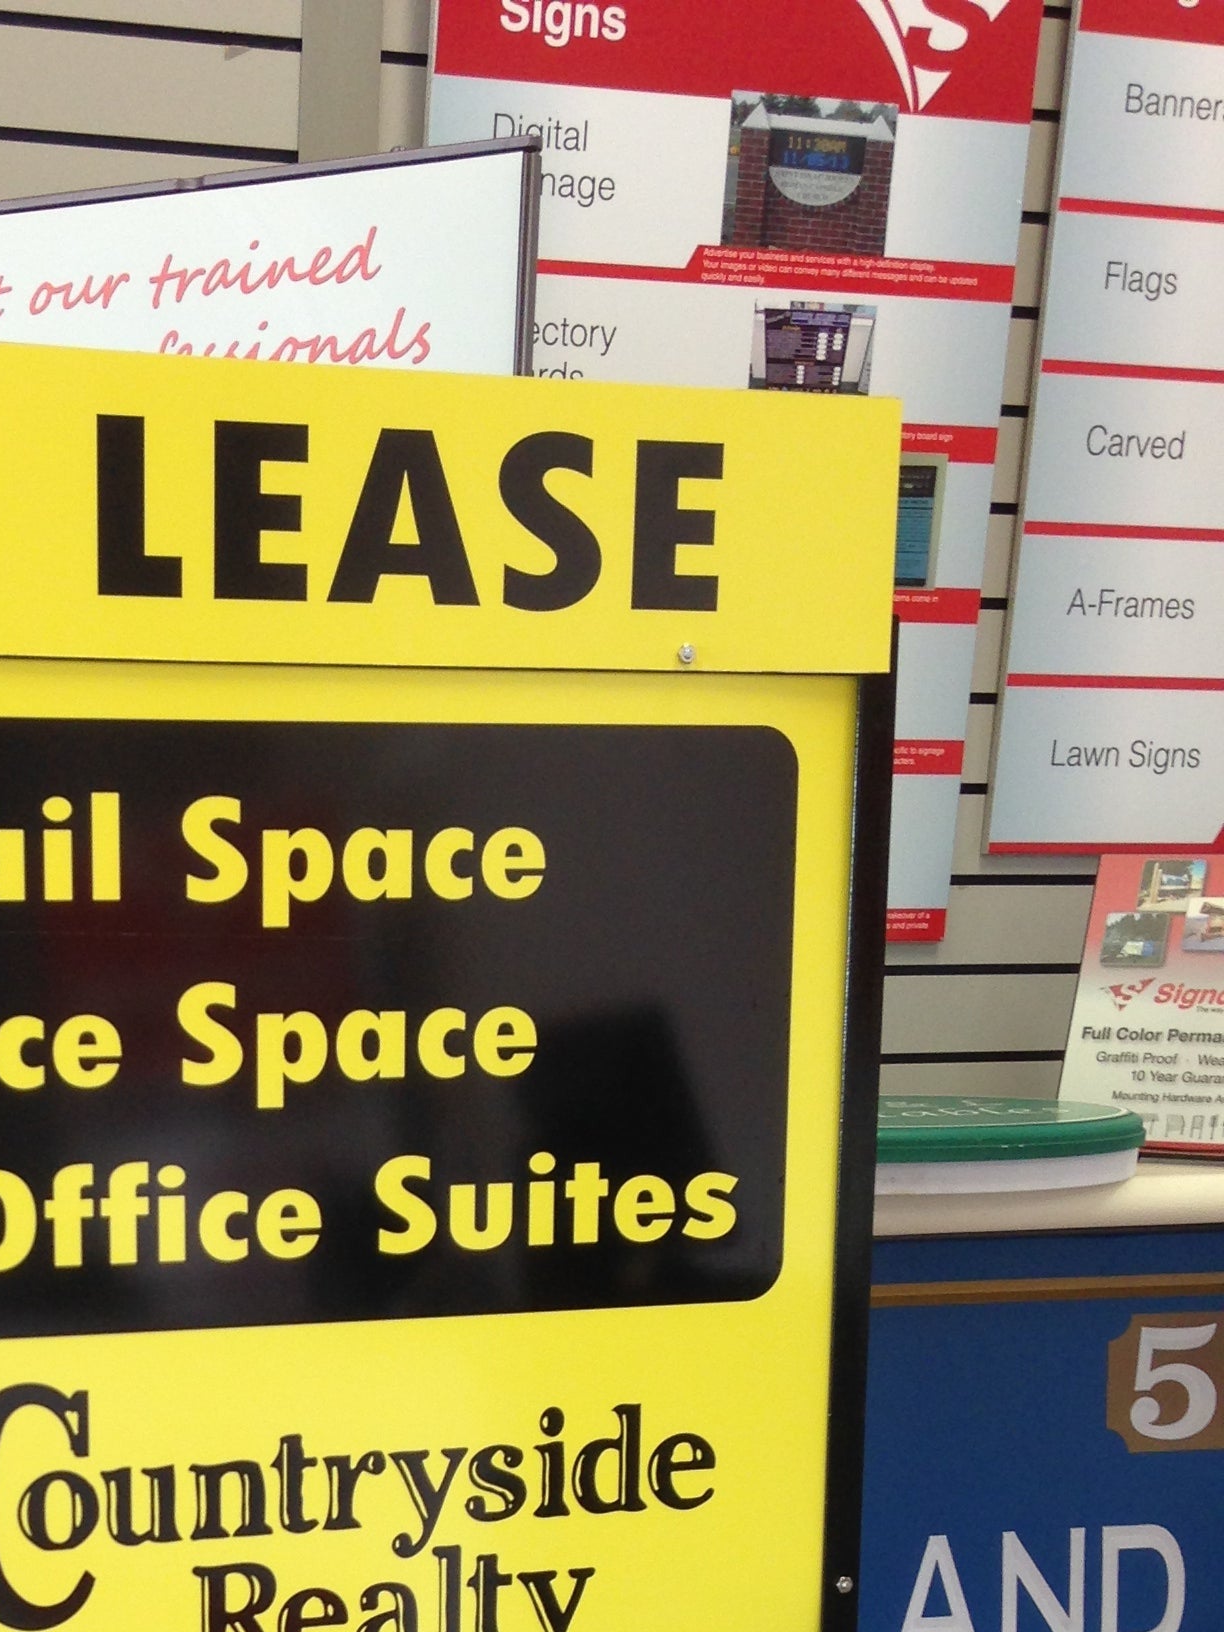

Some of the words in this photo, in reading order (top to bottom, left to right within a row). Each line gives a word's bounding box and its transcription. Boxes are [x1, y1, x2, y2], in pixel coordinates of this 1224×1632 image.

[500, 0, 626, 47] Signs
[29, 272, 131, 317] our
[149, 226, 382, 309] trained
[1104, 260, 1178, 300] Flags
[1086, 425, 1186, 462] Carved
[96, 414, 727, 614] LEASE
[1066, 588, 1195, 620] A-Frames
[1049, 739, 1120, 769] Lawn
[1129, 740, 1201, 774] Signs
[181, 796, 547, 928] Space
[176, 982, 539, 1109] Space
[1082, 1025, 1111, 1041] Full
[1116, 1027, 1162, 1042] Color
[1167, 1028, 1224, 1043] Perma
[1096, 1050, 1139, 1064] Graffiti
[1142, 1052, 1178, 1065] Proof
[1131, 1070, 1146, 1082] 10
[1150, 1070, 1178, 1083] Year
[1182, 1071, 1224, 1084] Guara
[1112, 1090, 1159, 1104] Mounting
[1162, 1092, 1212, 1104] Hardware
[375, 1152, 738, 1254] Suites
[1130, 1323, 1217, 1440] 5
